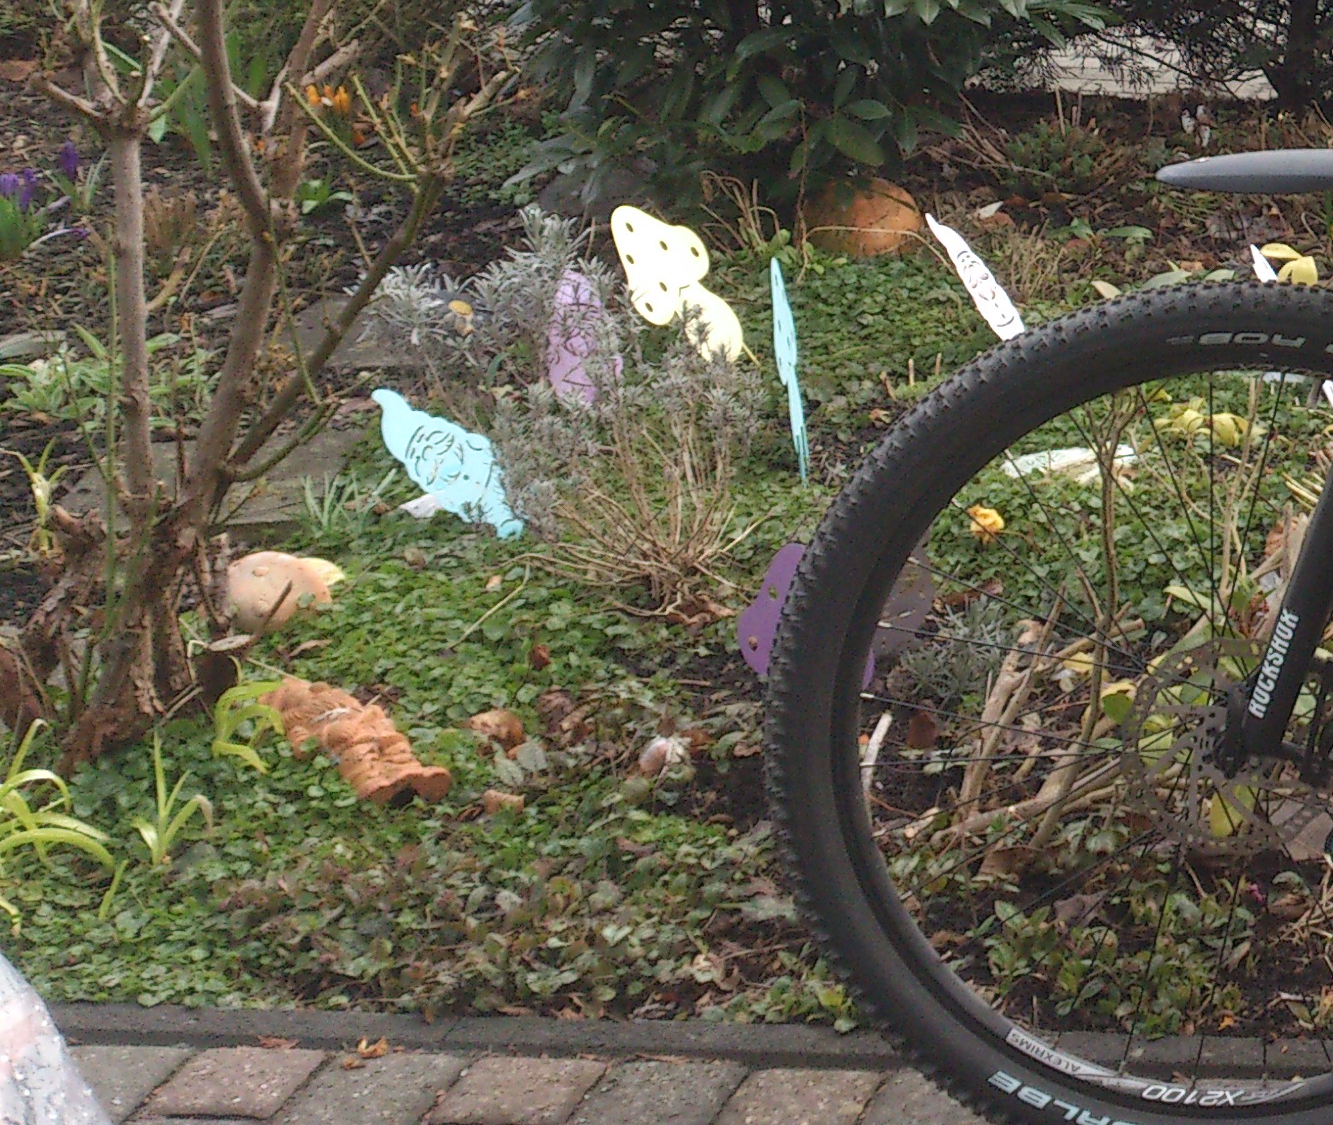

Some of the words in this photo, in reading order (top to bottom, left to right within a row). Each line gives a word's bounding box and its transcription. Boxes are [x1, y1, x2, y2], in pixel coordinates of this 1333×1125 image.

[1249, 608, 1300, 720] ROCKSHOX
[1010, 1032, 1081, 1073] ALEXRIMS
[987, 1070, 1120, 1125] ALBE
[1141, 1084, 1245, 1106] X2100
